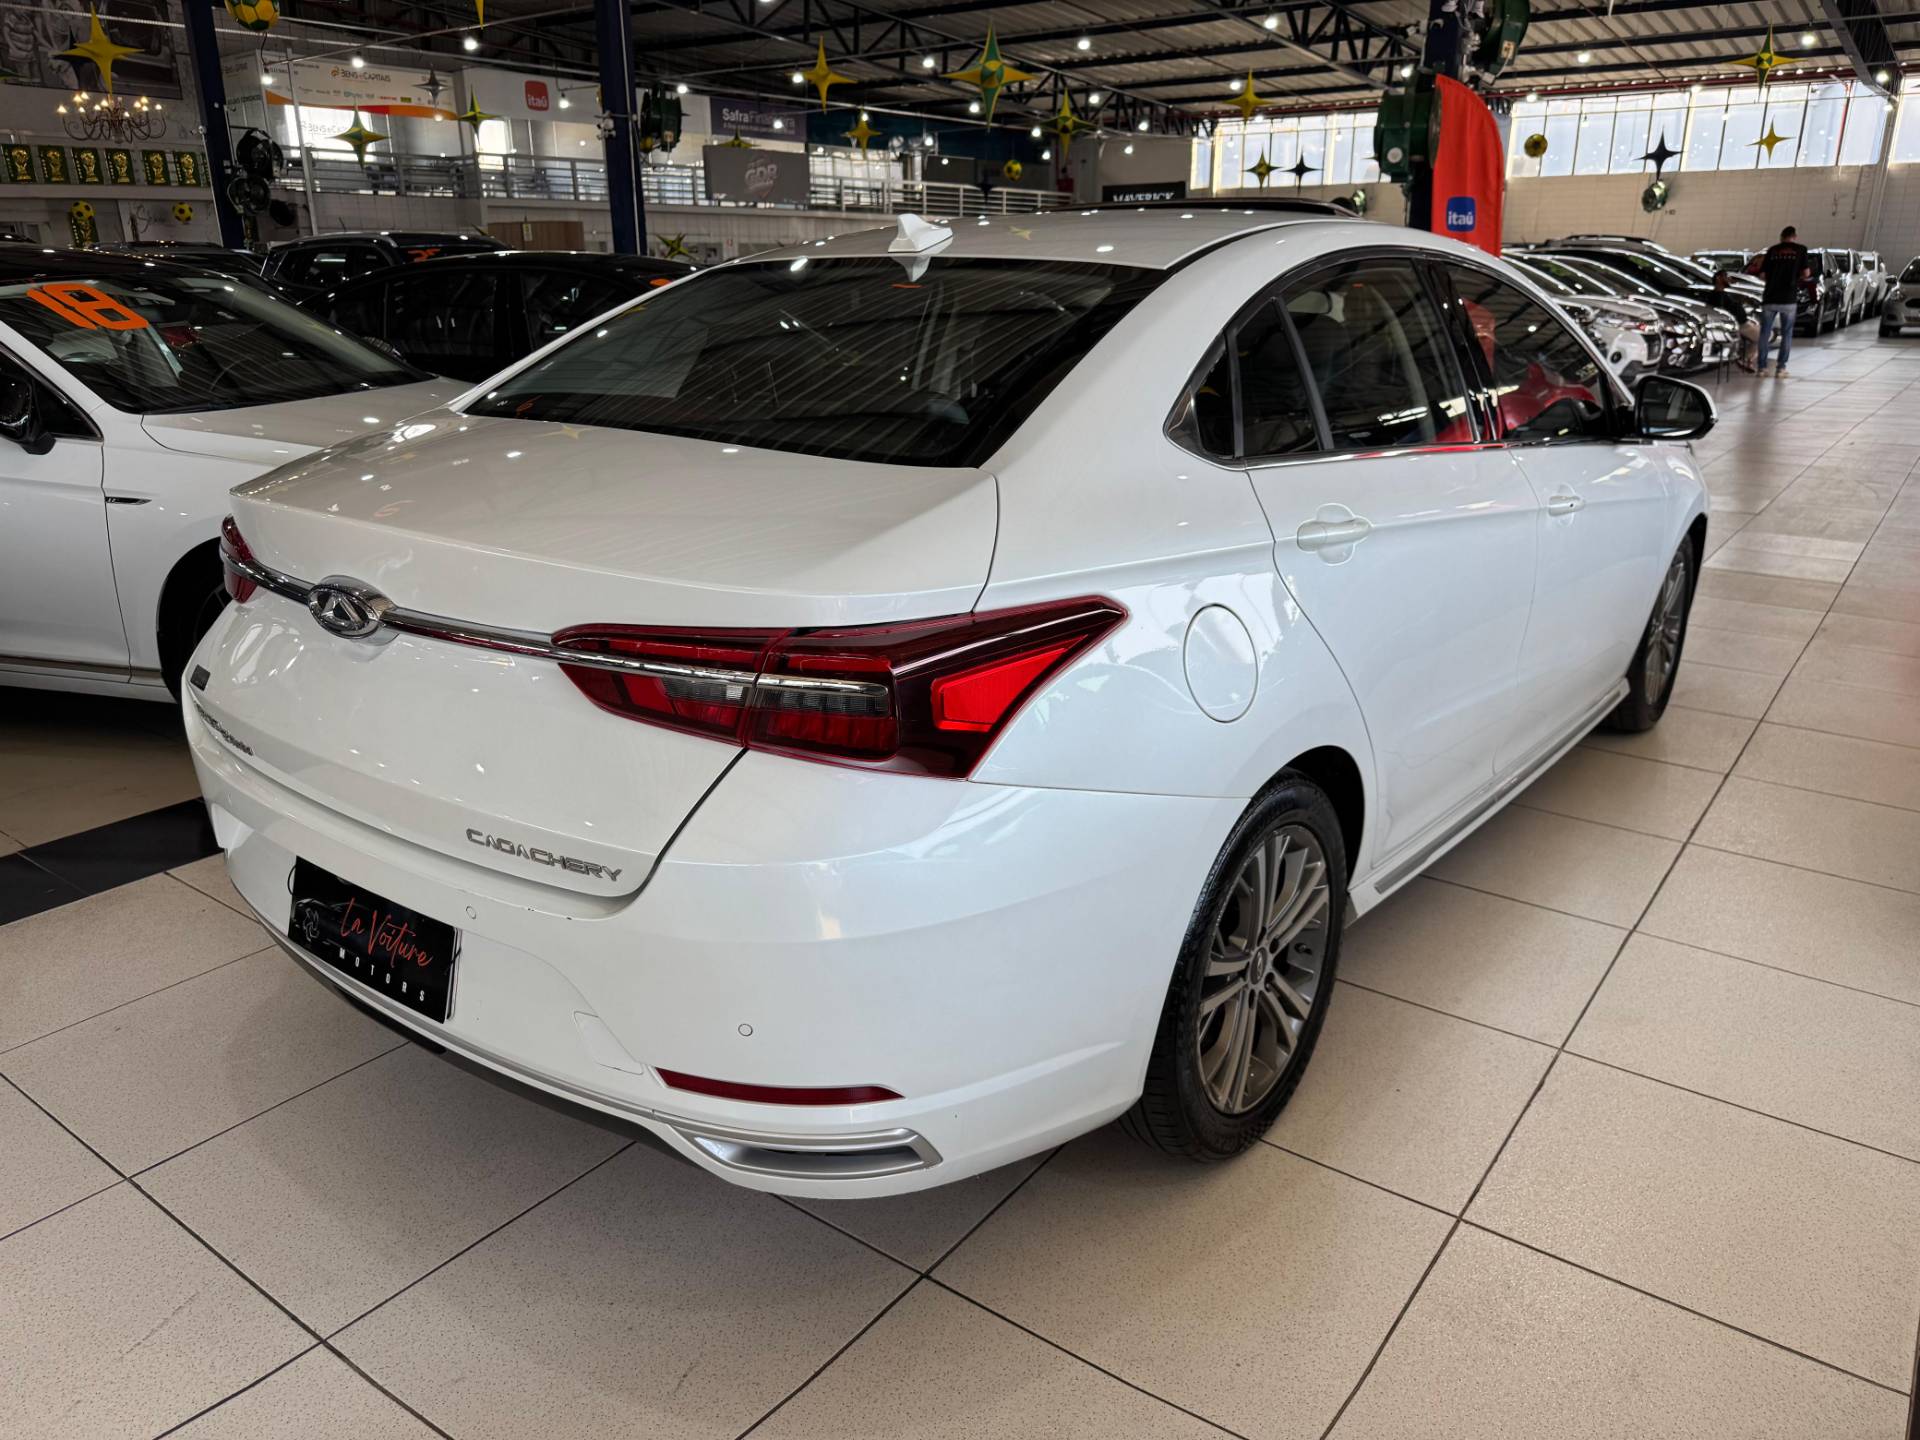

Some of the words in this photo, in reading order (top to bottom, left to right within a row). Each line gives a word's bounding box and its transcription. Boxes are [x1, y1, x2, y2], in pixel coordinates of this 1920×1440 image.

[1448, 210, 1473, 226] itaú
[27, 283, 149, 330] 18
[339, 898, 365, 937] La
[368, 910, 433, 968] Voiture
[339, 948, 425, 1001] MOTORS
